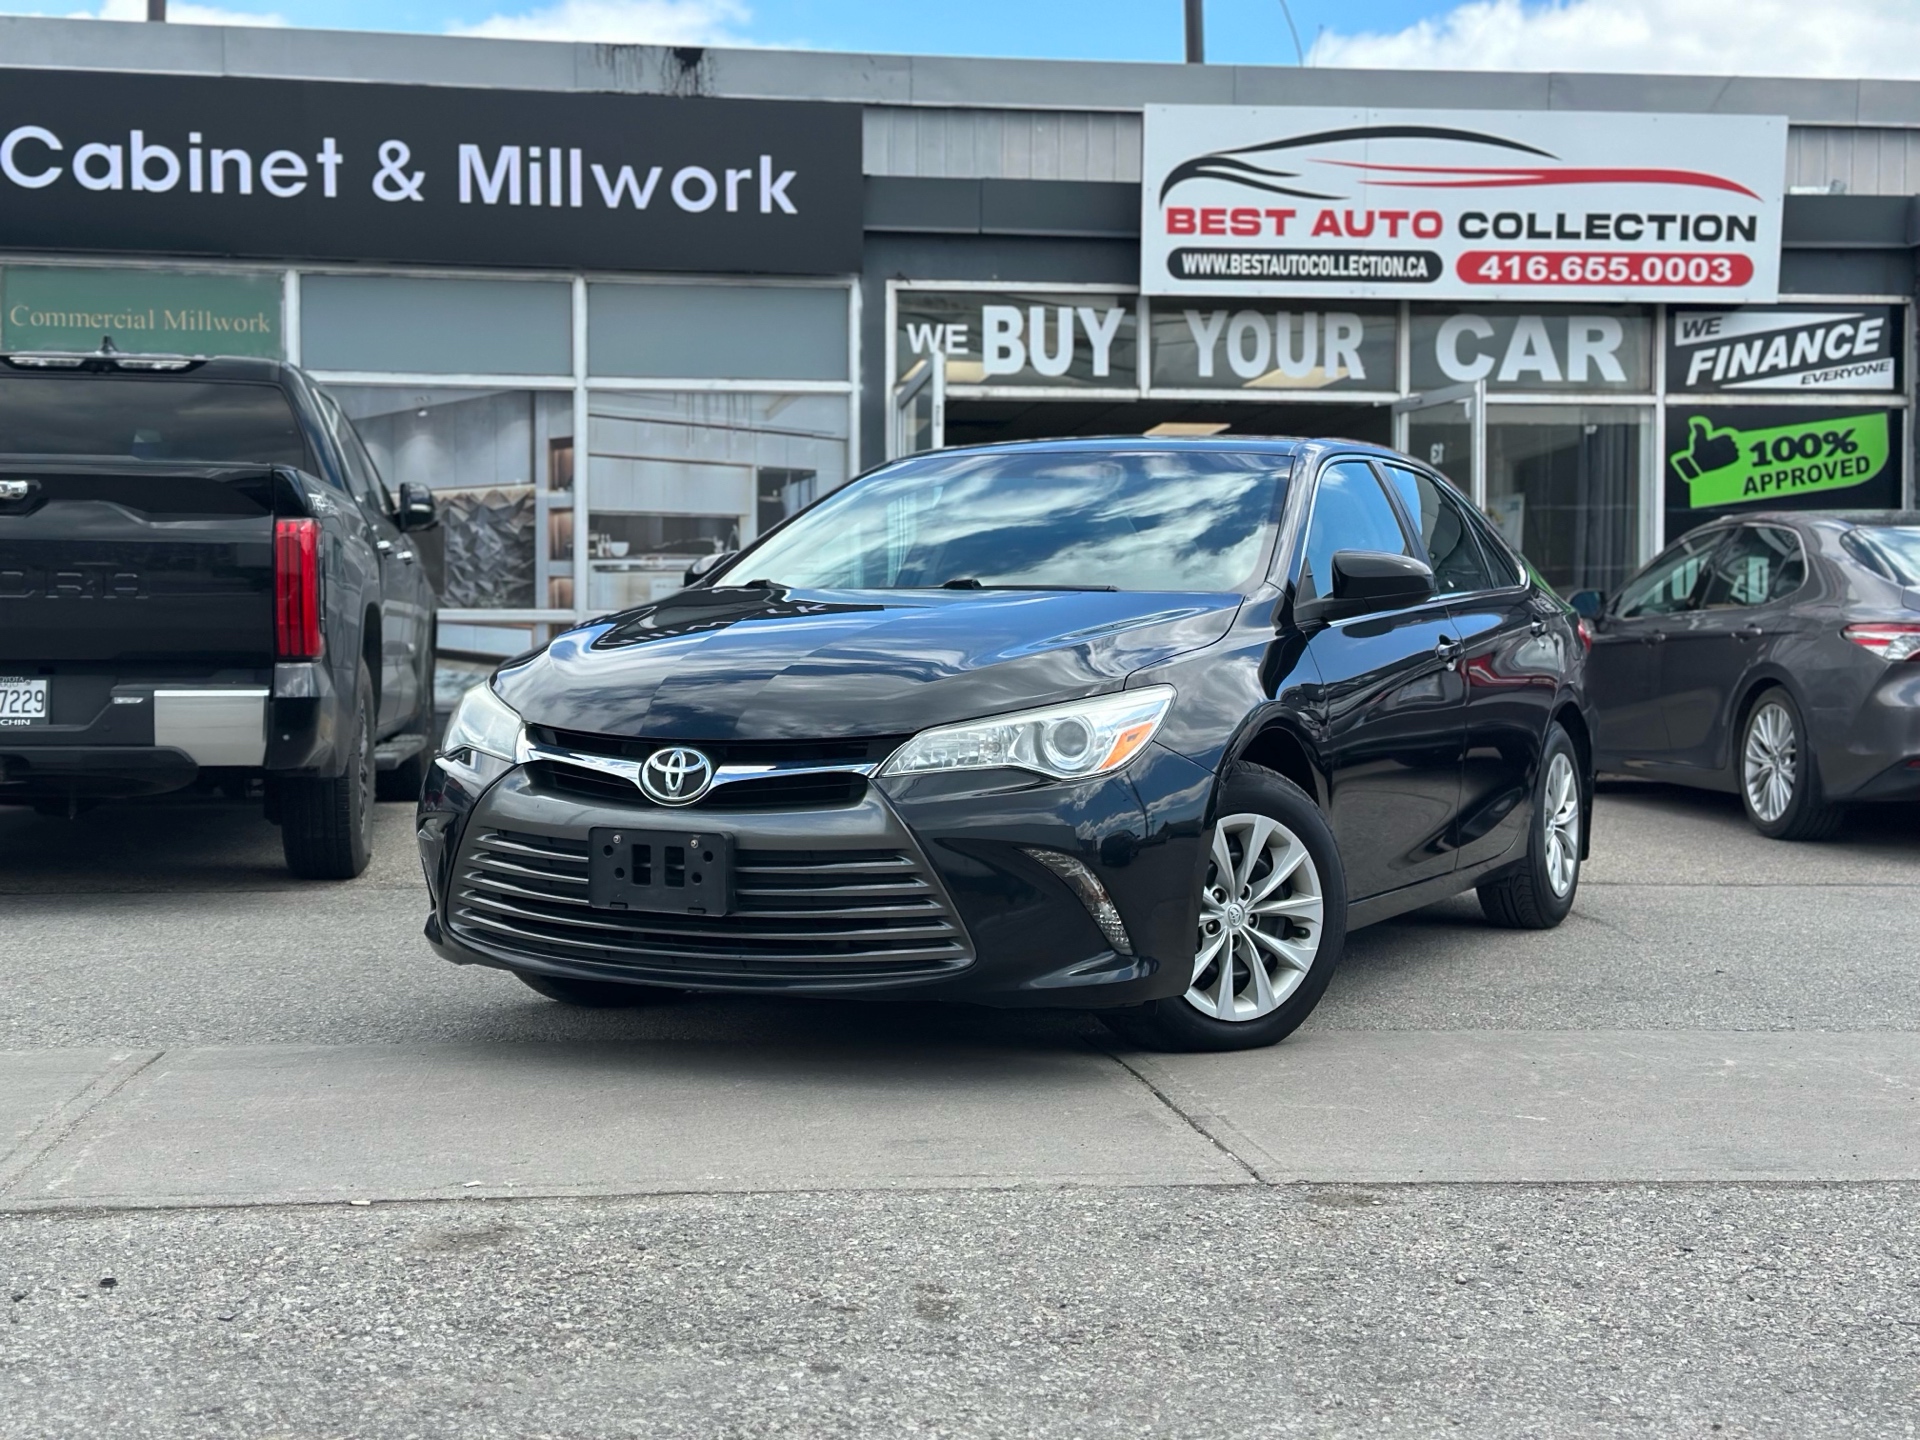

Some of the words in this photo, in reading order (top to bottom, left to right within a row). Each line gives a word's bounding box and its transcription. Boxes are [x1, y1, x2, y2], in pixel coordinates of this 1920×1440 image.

[0, 125, 343, 198] Cabinet
[372, 139, 424, 202] &
[458, 143, 798, 214] Millwork
[1166, 207, 1296, 237] BEST
[1310, 209, 1443, 239] AUTO
[1458, 211, 1757, 242] COLLECTION
[1182, 252, 1428, 278] WWW.BESTAUTOCOLLECTION.CA
[10, 305, 155, 330] Commercial
[164, 309, 271, 333] Millwork
[1682, 316, 1723, 340] WE
[906, 323, 969, 354] WE
[982, 305, 1126, 377] BUY
[1183, 309, 1366, 380] YOUR
[1435, 313, 1627, 382] CAR
[1685, 317, 1885, 387] FINANCE
[1800, 360, 1891, 386] EVERYONE
[1748, 428, 1860, 468] 100%
[1742, 455, 1872, 496] APPROVED
